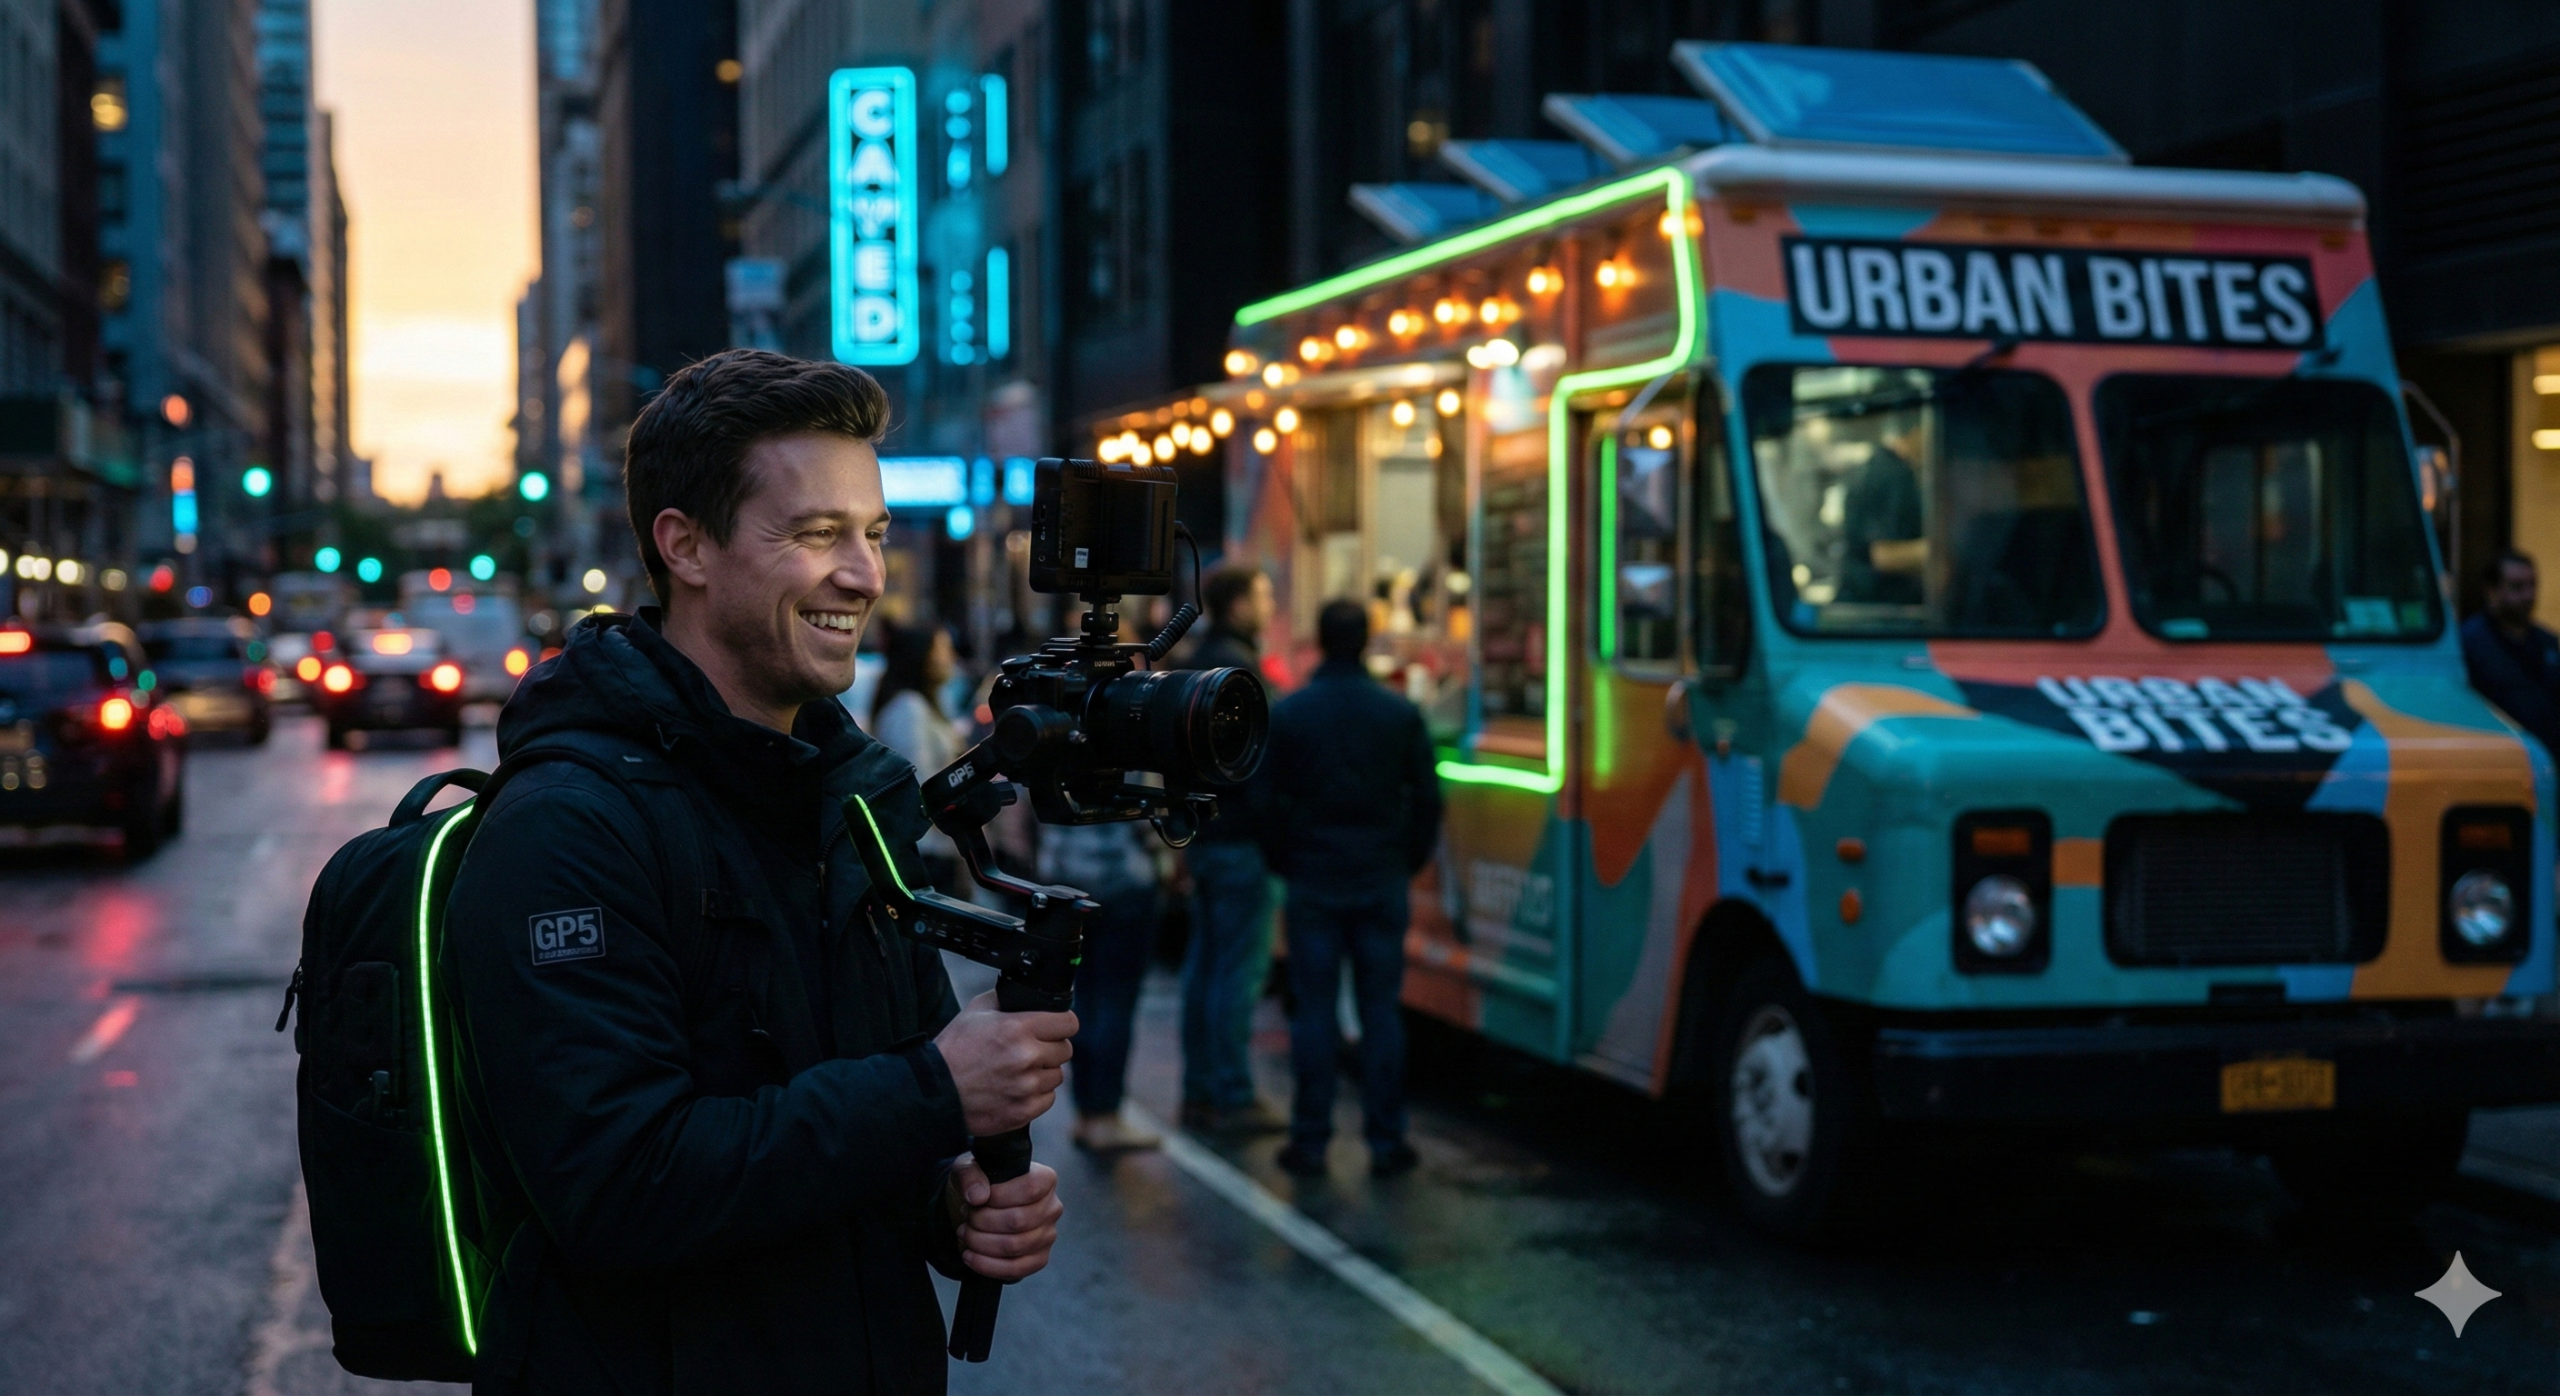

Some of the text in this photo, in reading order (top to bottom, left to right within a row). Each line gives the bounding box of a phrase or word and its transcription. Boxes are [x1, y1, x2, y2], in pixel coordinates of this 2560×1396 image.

[1792, 244, 2313, 344] URBAN BITES
[2036, 676, 2308, 708] URBAN
[2068, 706, 2352, 752] BITES
[535, 913, 598, 951] GP5
